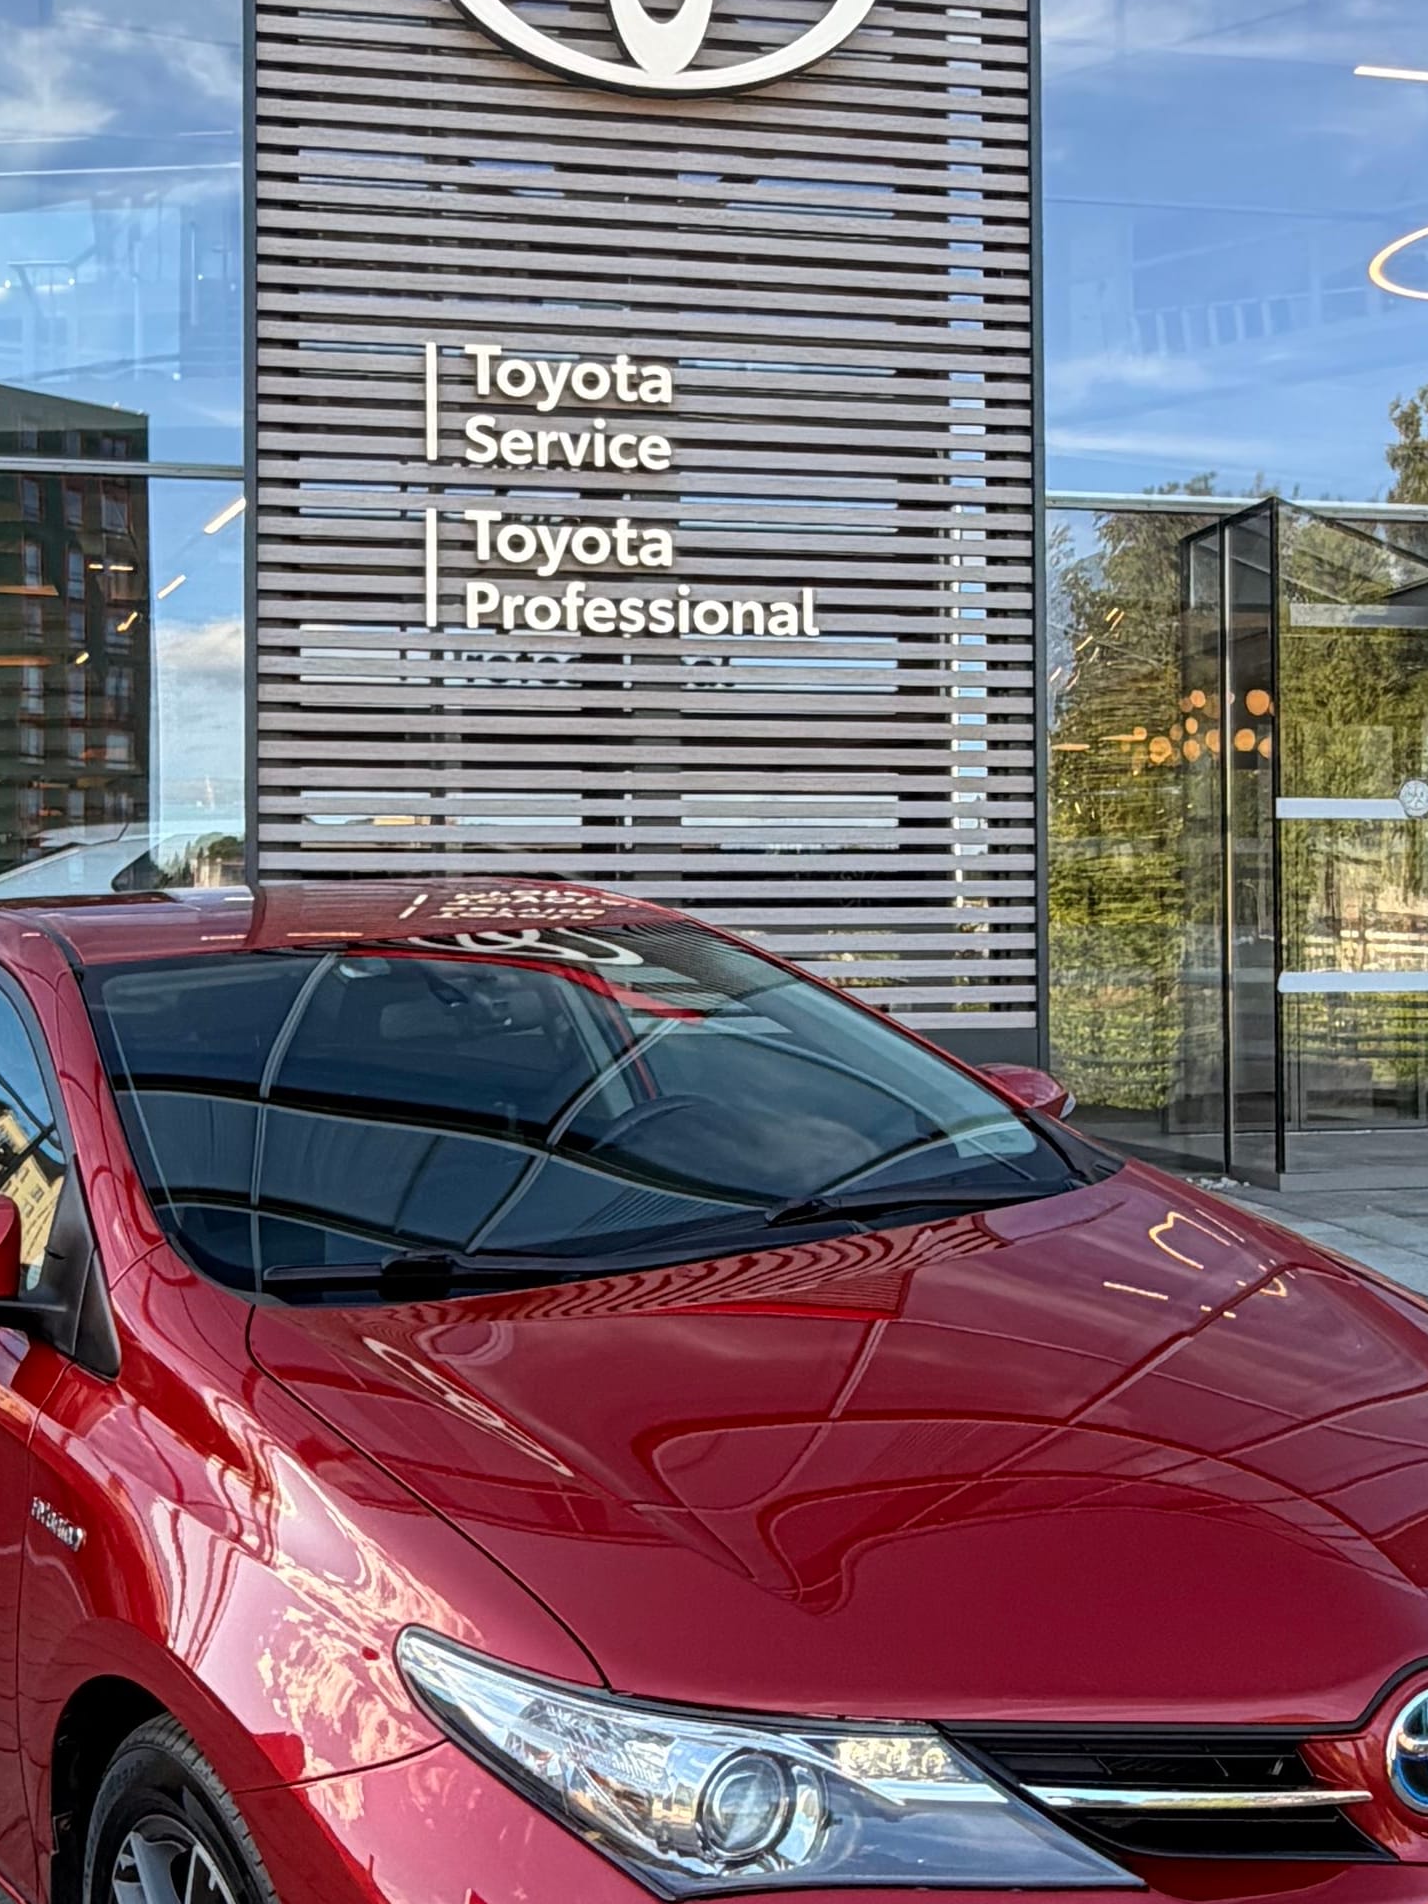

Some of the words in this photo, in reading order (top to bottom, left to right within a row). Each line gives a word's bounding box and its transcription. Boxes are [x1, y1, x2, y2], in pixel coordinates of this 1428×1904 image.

[464, 343, 673, 413] Toyota
[464, 414, 673, 471] Service
[464, 509, 673, 577] Toyota
[465, 580, 820, 637] Professional
